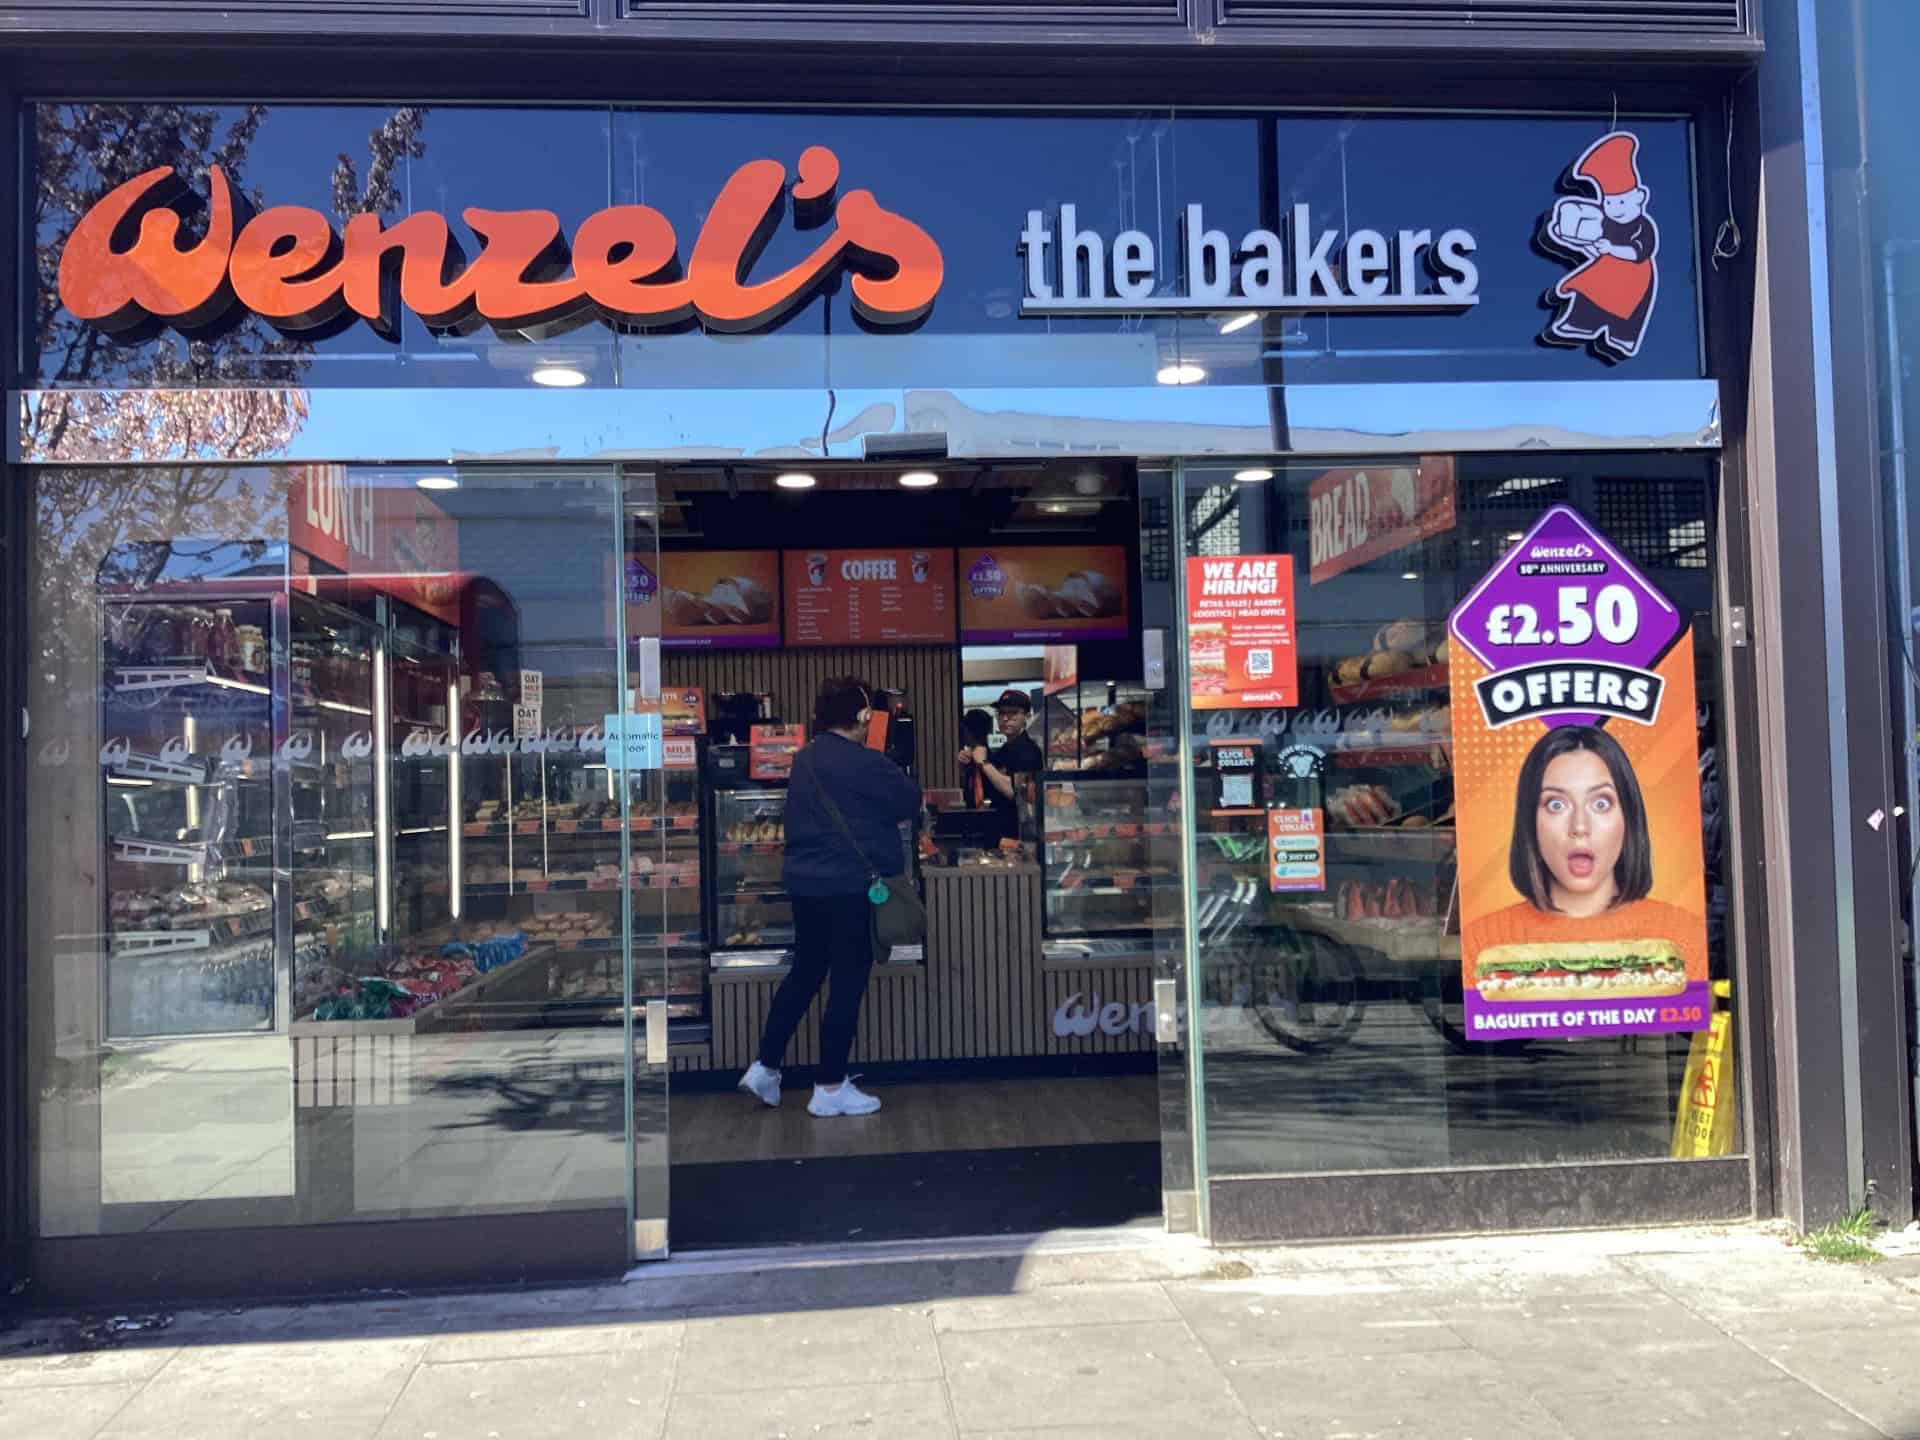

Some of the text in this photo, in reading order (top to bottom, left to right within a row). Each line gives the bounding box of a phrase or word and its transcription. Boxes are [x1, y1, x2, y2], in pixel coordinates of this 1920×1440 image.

[58, 146, 944, 321] Wenzel's
[1020, 204, 1480, 300] the bakers
[306, 464, 374, 560] LUNCH
[1311, 471, 1370, 567] BREAD
[1530, 544, 1593, 558] Wenzel's
[841, 559, 897, 580] COFFEE
[1203, 561, 1277, 578] WE ARE
[1540, 563, 1605, 573] ANNIVERSARY
[1203, 579, 1277, 595] HIRING!
[1485, 584, 1638, 645] £2.50
[1492, 671, 1649, 713] OFFERS
[518, 709, 537, 718] OAT
[1218, 751, 1243, 759] CLICK
[1218, 758, 1254, 767] COLLECT
[1274, 815, 1299, 823] CLICK
[1279, 823, 1315, 832] COLLECT
[1474, 1006, 1702, 1030] BAGUETTE OF THE DAY £2.50
